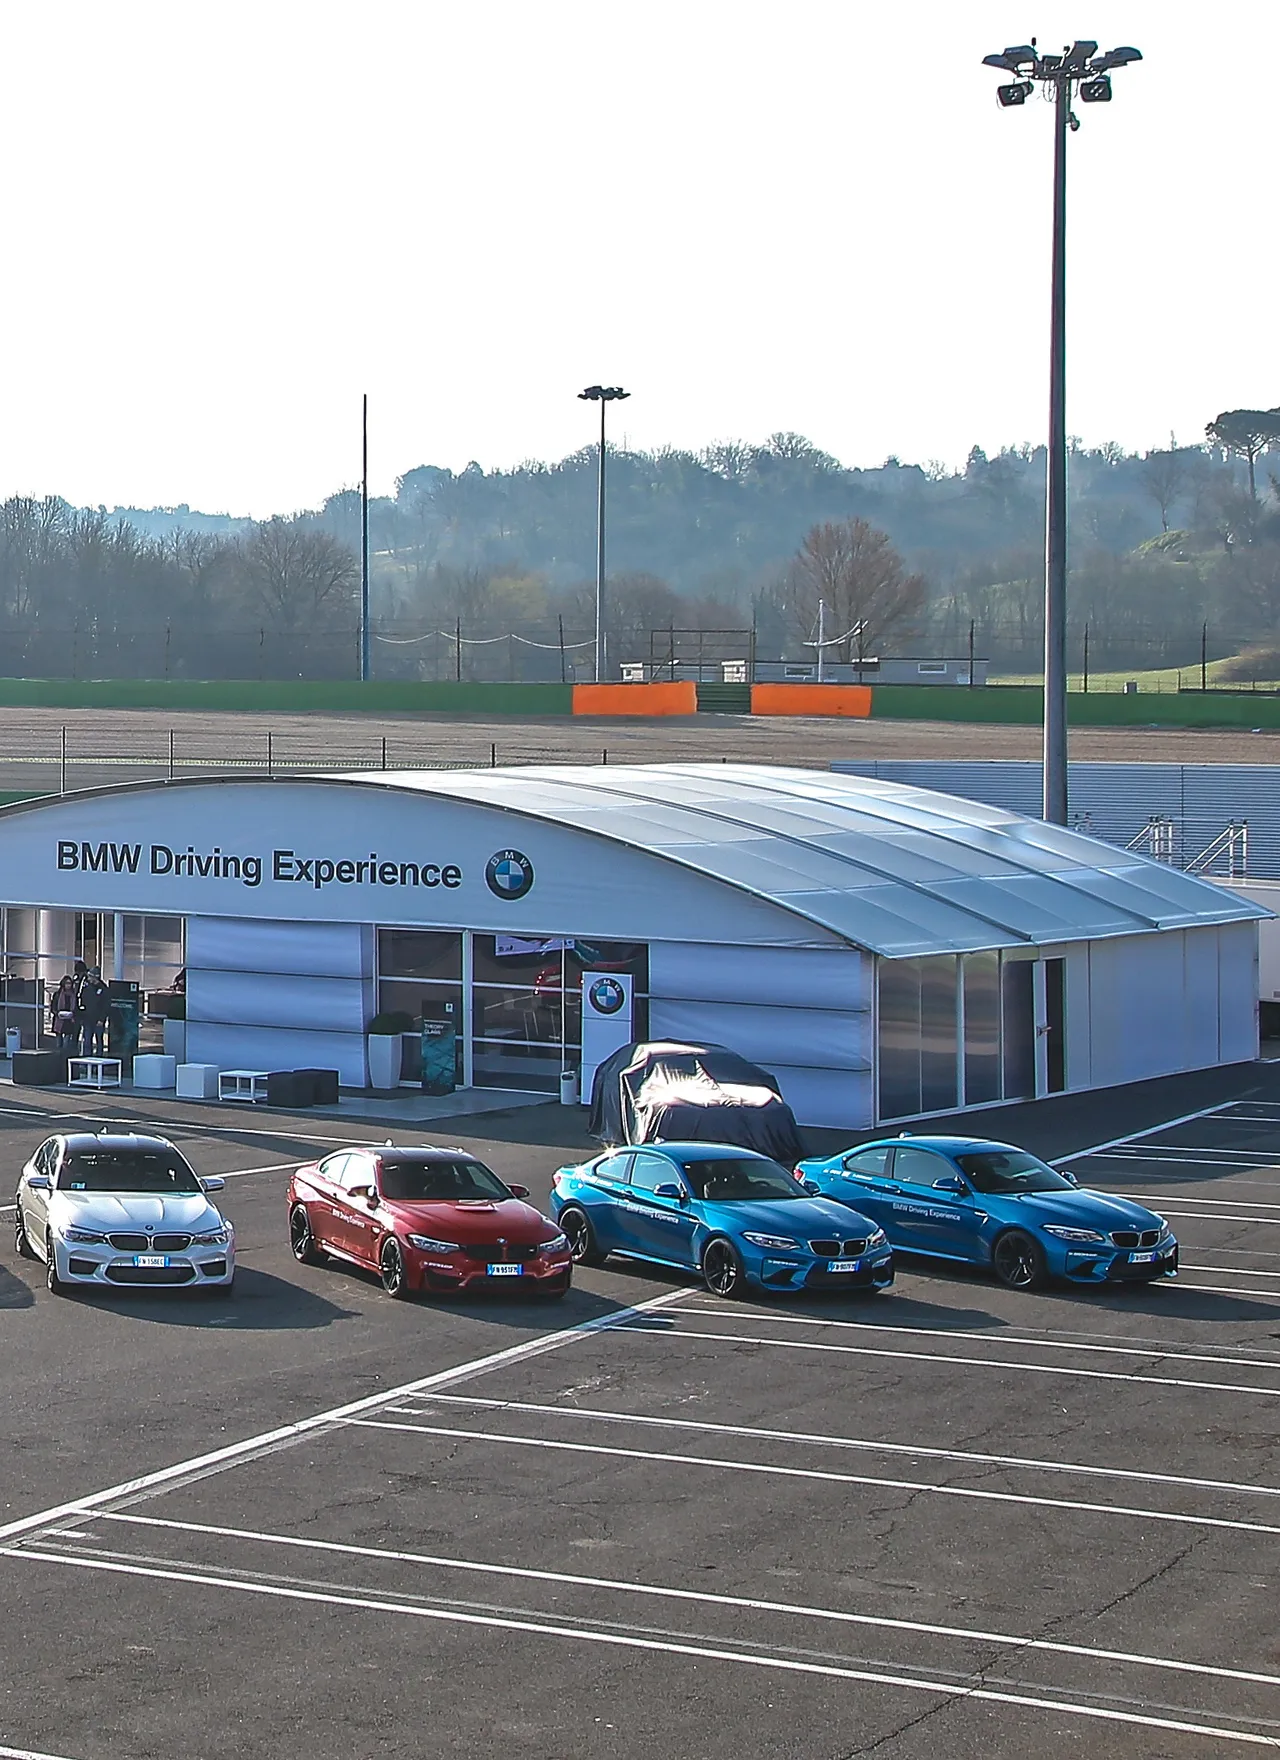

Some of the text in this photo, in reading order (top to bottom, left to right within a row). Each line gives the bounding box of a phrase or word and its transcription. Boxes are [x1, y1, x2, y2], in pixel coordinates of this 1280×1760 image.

[57, 841, 462, 889] BMW Driving Experience
[490, 851, 530, 868] BMW
[893, 1203, 961, 1221] BMW Driving Experience
